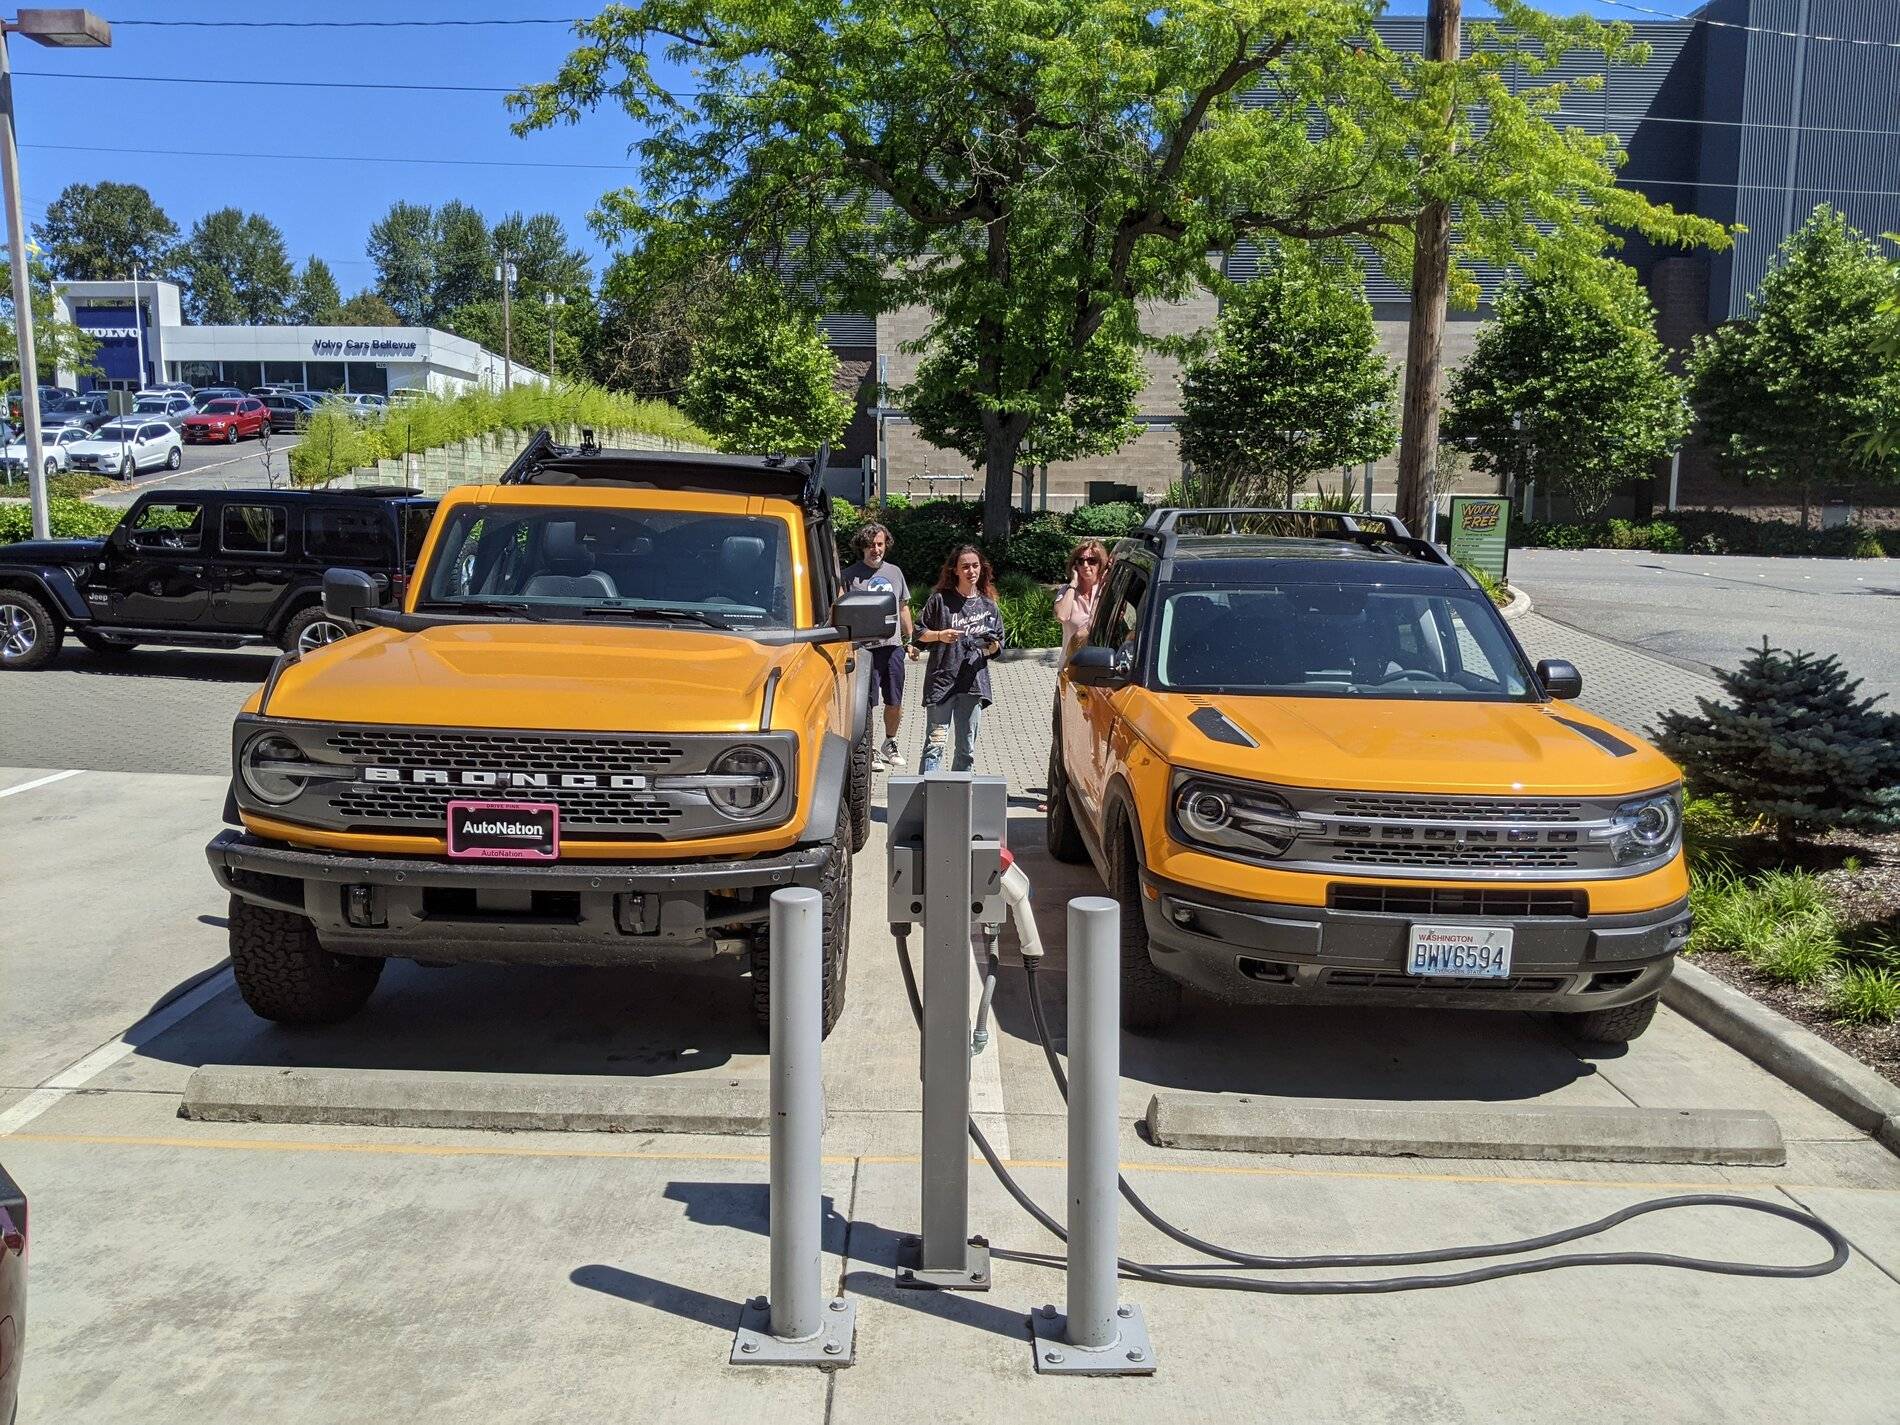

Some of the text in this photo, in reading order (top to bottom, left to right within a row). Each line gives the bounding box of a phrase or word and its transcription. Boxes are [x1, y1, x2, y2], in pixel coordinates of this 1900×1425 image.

[80, 328, 140, 338] VOLVO
[314, 339, 417, 349] Volvo Cars Bellevue
[1462, 515, 1498, 530] FREE
[89, 592, 108, 601] Jeep
[364, 767, 646, 789] BRONCO
[462, 820, 544, 836] AutoNation
[1338, 825, 1578, 842] BRONCO
[481, 850, 523, 858] AutoNation
[1418, 933, 1474, 943] WASHINGTON
[1415, 943, 1504, 970] BWV6594
